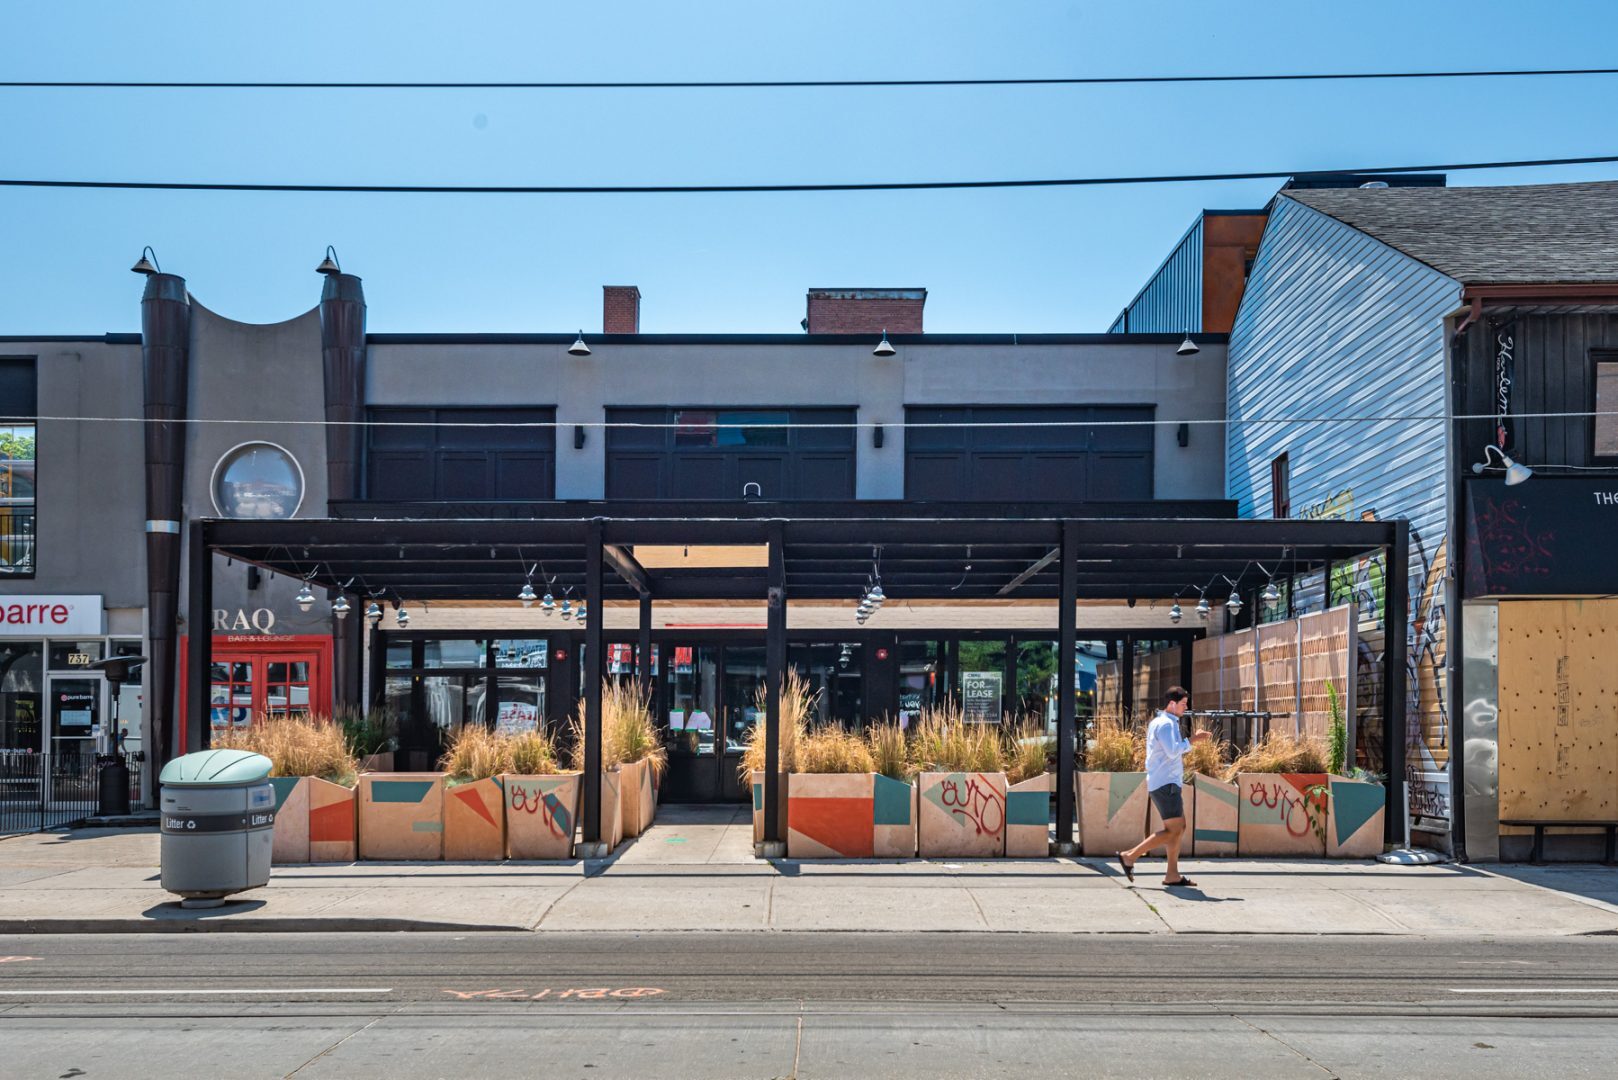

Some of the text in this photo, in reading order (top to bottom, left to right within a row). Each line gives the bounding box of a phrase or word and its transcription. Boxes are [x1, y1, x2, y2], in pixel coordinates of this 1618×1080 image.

[1498, 334, 1513, 416] Harlem
[0, 604, 68, 624] arre
[69, 654, 88, 663] 737
[967, 681, 985, 689] FOR
[967, 690, 993, 698] LEASE
[166, 817, 184, 829] Litter
[252, 815, 268, 826] Litter
